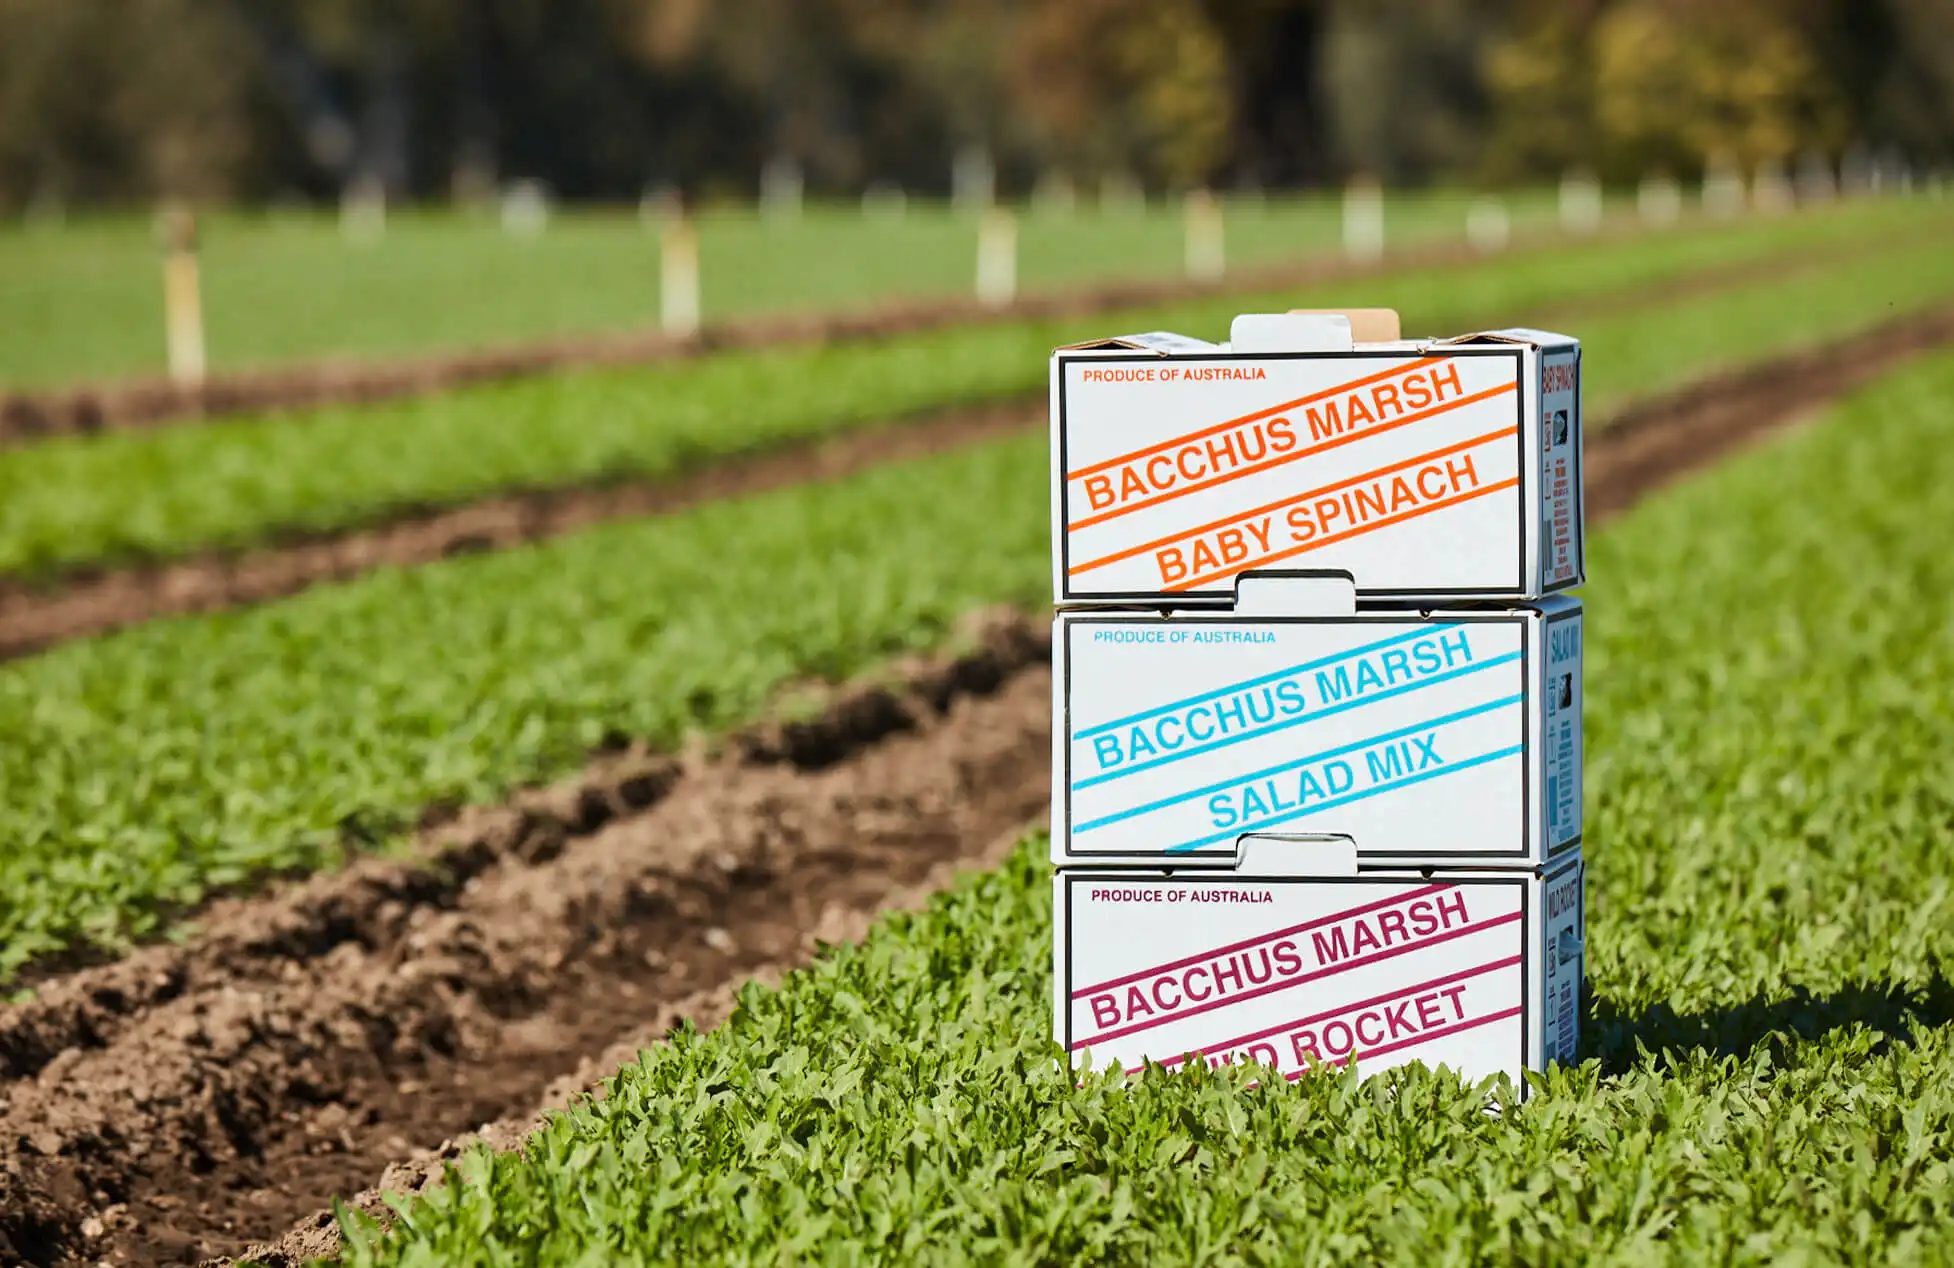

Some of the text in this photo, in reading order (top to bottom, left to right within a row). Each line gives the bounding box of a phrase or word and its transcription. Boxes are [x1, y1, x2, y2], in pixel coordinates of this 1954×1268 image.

[1084, 368, 1266, 383] PRODUCE OF AUSTRALIA
[1084, 416, 1297, 511] BACCHUS
[1304, 363, 1463, 441] MARSH
[1155, 517, 1271, 585] BABY
[1286, 454, 1480, 542] SPINACH
[1093, 631, 1276, 643] PRODUCE OF AUSTRALIA
[1093, 679, 1306, 769] BACCHUS
[1315, 630, 1473, 704] MARSH
[1208, 733, 1444, 829] SALAD MIX
[1091, 889, 1273, 903] PRODUCE OF AUSTRALIA
[1090, 940, 1303, 1030] BACCHUS
[1312, 891, 1470, 965] MARSH
[1290, 985, 1466, 1067] ROCKET
